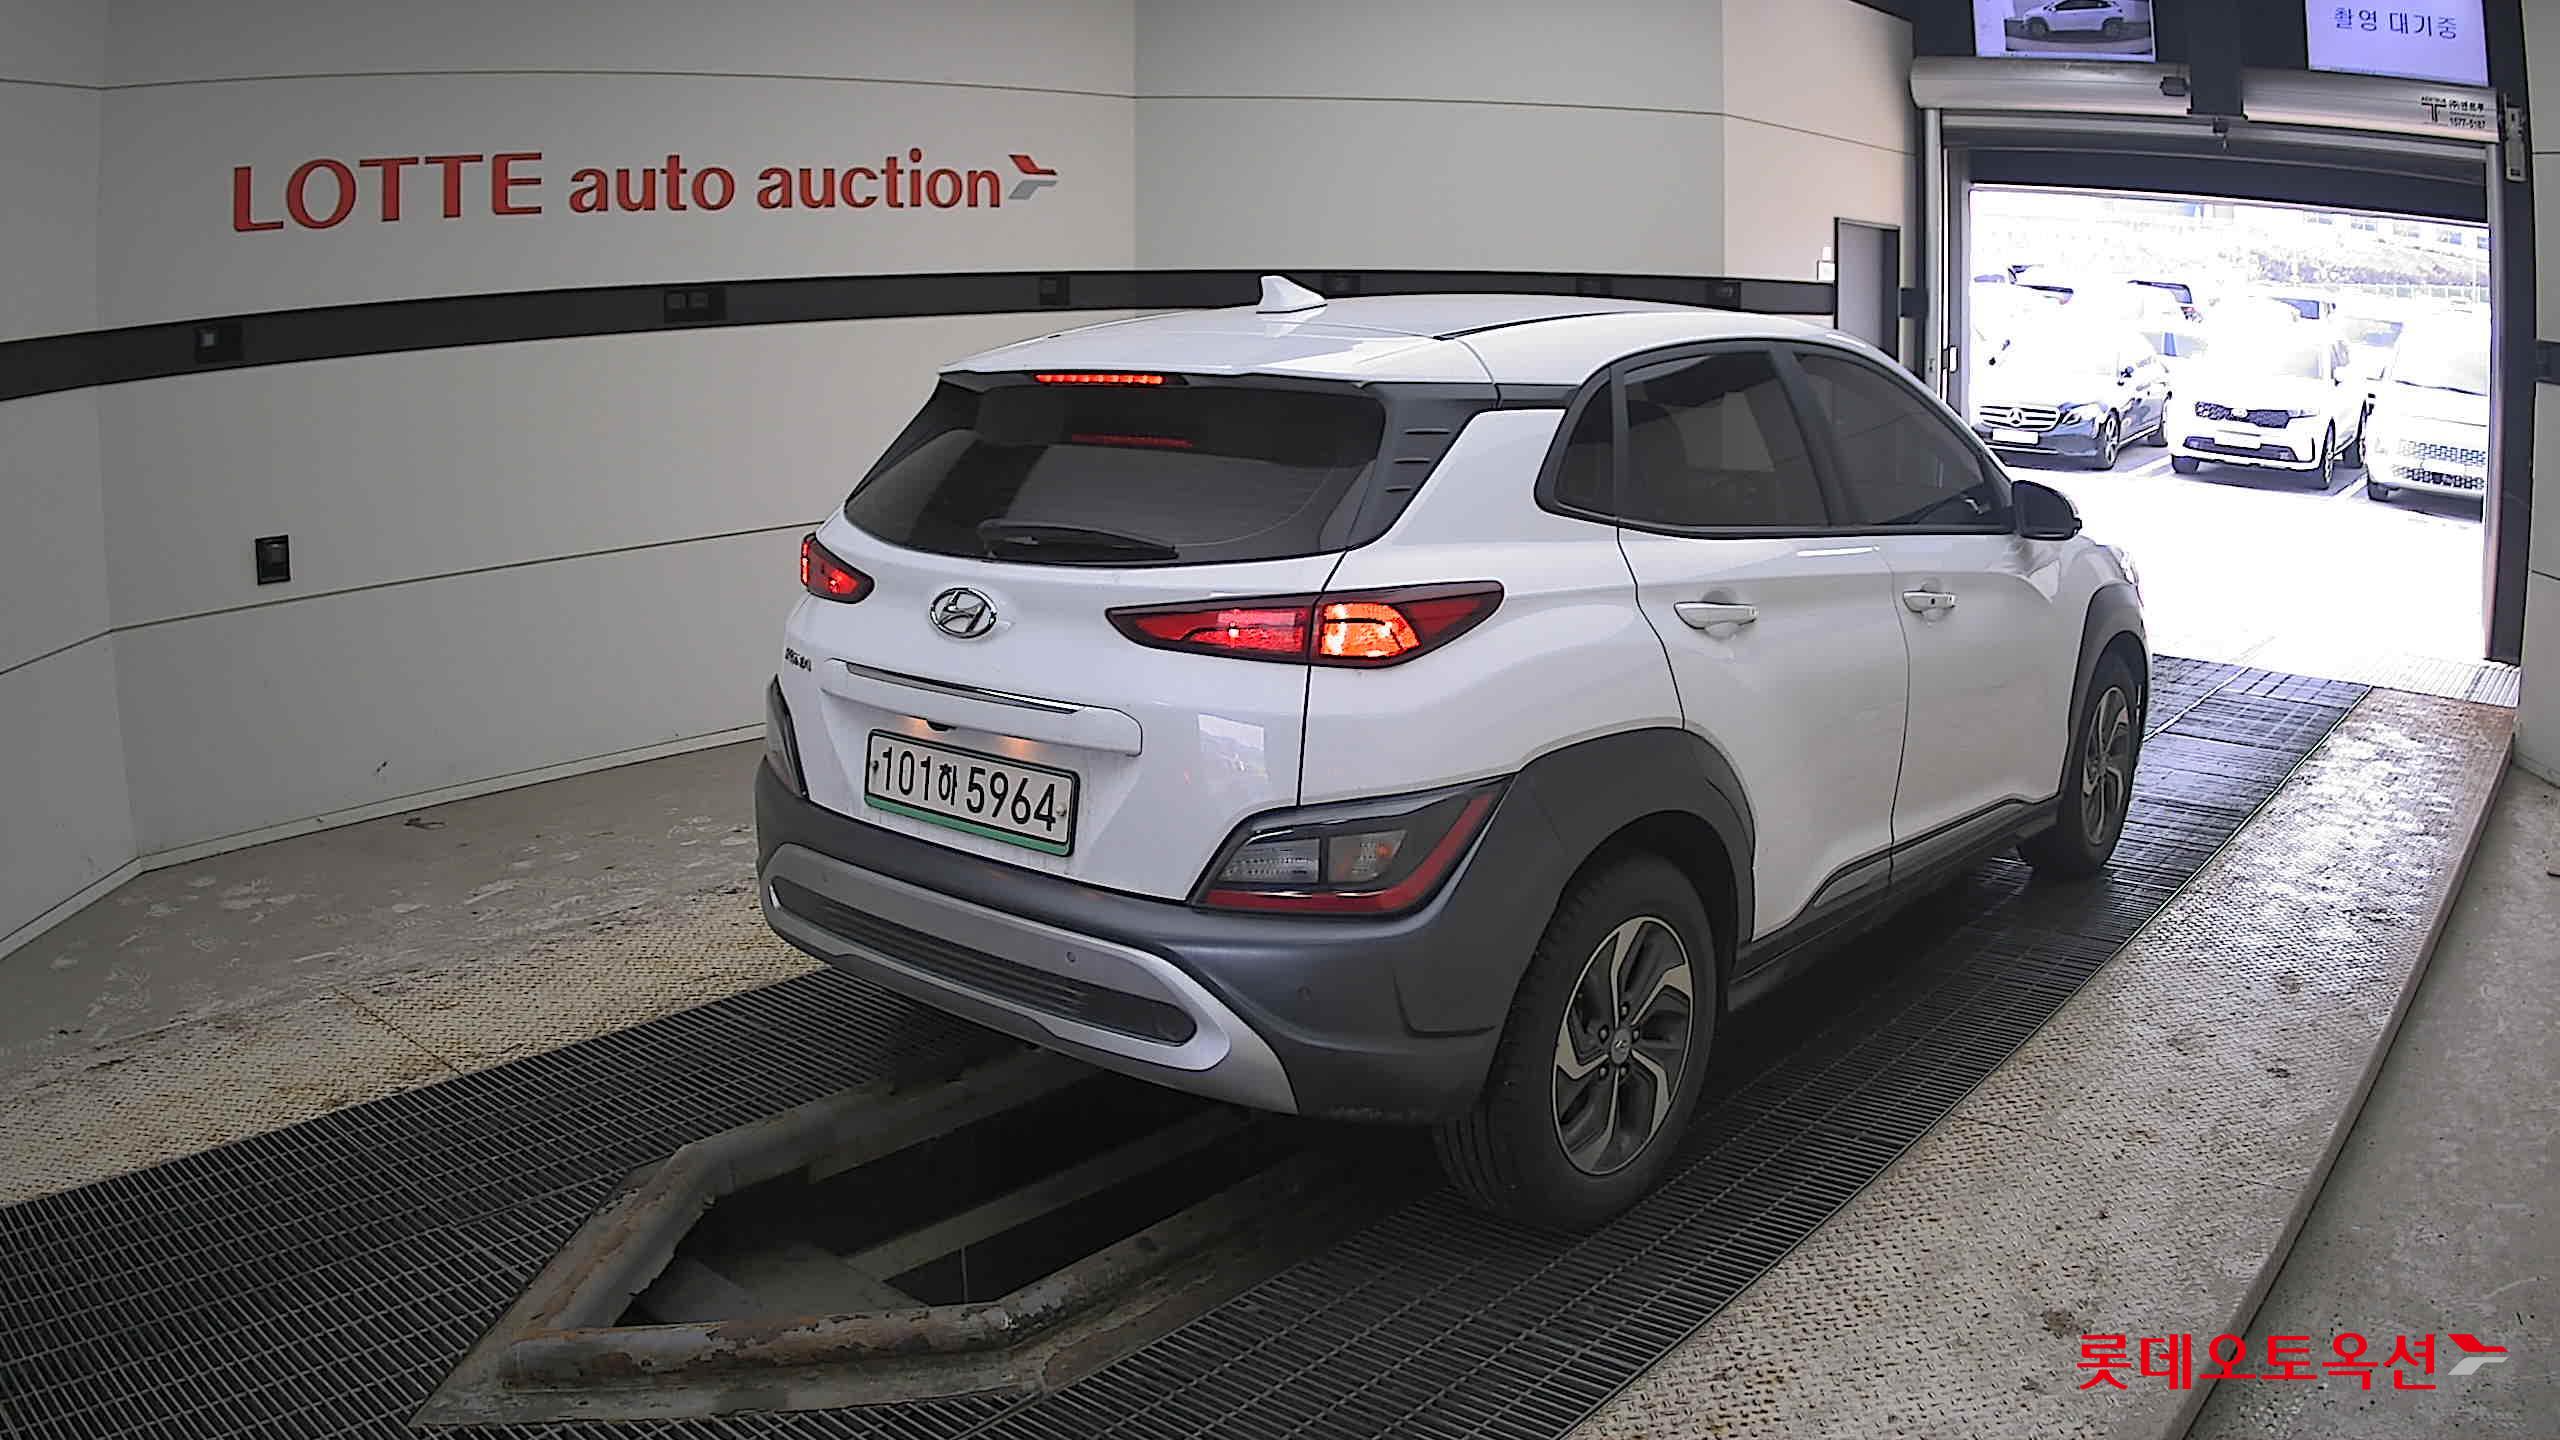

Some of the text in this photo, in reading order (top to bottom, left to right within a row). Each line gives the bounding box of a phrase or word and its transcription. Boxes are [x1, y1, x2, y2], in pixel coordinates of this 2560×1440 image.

[2334, 7, 2457, 40] 촬영 대기중
[233, 147, 1002, 232] LOTTE auto auction
[881, 745, 1057, 832] 101하5964
